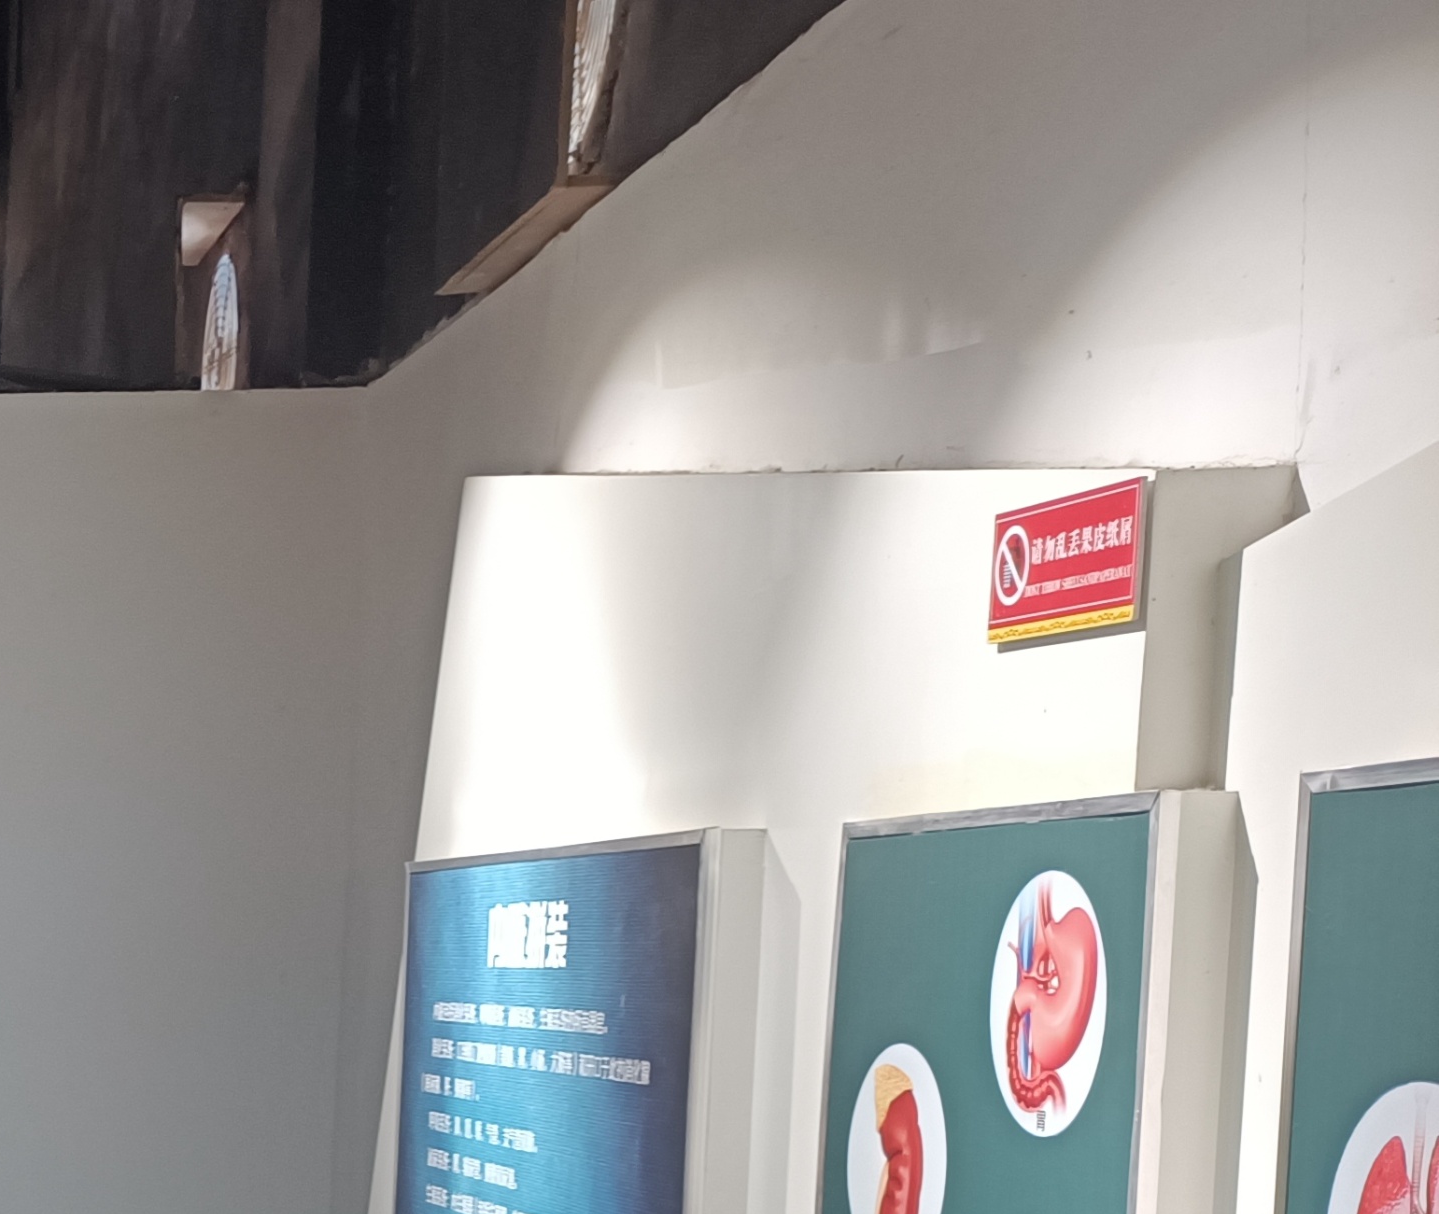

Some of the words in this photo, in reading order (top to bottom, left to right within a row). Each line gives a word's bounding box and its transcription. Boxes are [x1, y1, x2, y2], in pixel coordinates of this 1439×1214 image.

[1031, 515, 1134, 565] 请勿乱丢果皮纸屑
